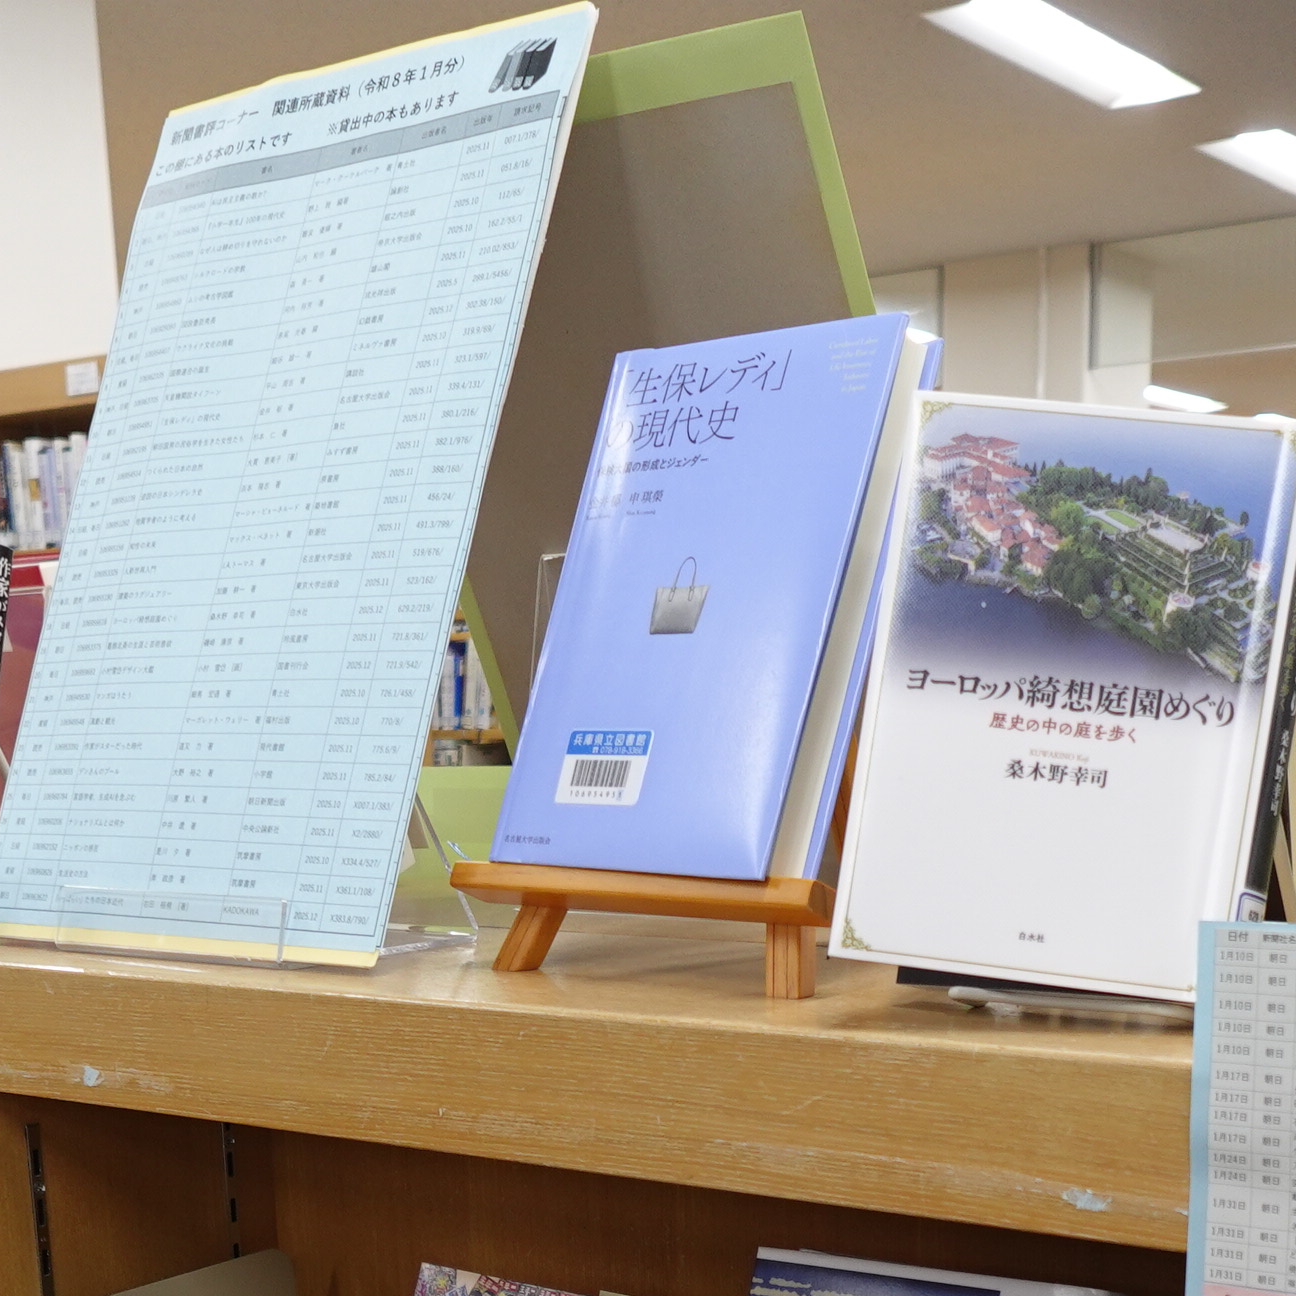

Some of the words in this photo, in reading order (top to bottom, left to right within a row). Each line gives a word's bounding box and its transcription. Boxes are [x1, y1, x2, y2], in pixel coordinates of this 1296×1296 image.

[171, 109, 259, 146] 新聞書評コーナー
[272, 85, 351, 117] 関連所蔵資料
[155, 131, 292, 176] この棚にある本のリストです
[607, 400, 741, 452] の現代史
[906, 667, 1236, 727] ヨーロッパ綺想庭園めぐり
[573, 733, 647, 747] 兵庫県立図書館
[989, 711, 1137, 744] 歴史の中の庭を歩く
[1004, 758, 1109, 789] 桑木野幸司
[1018, 931, 1046, 944] 白水社
[1227, 931, 1249, 944] 日付
